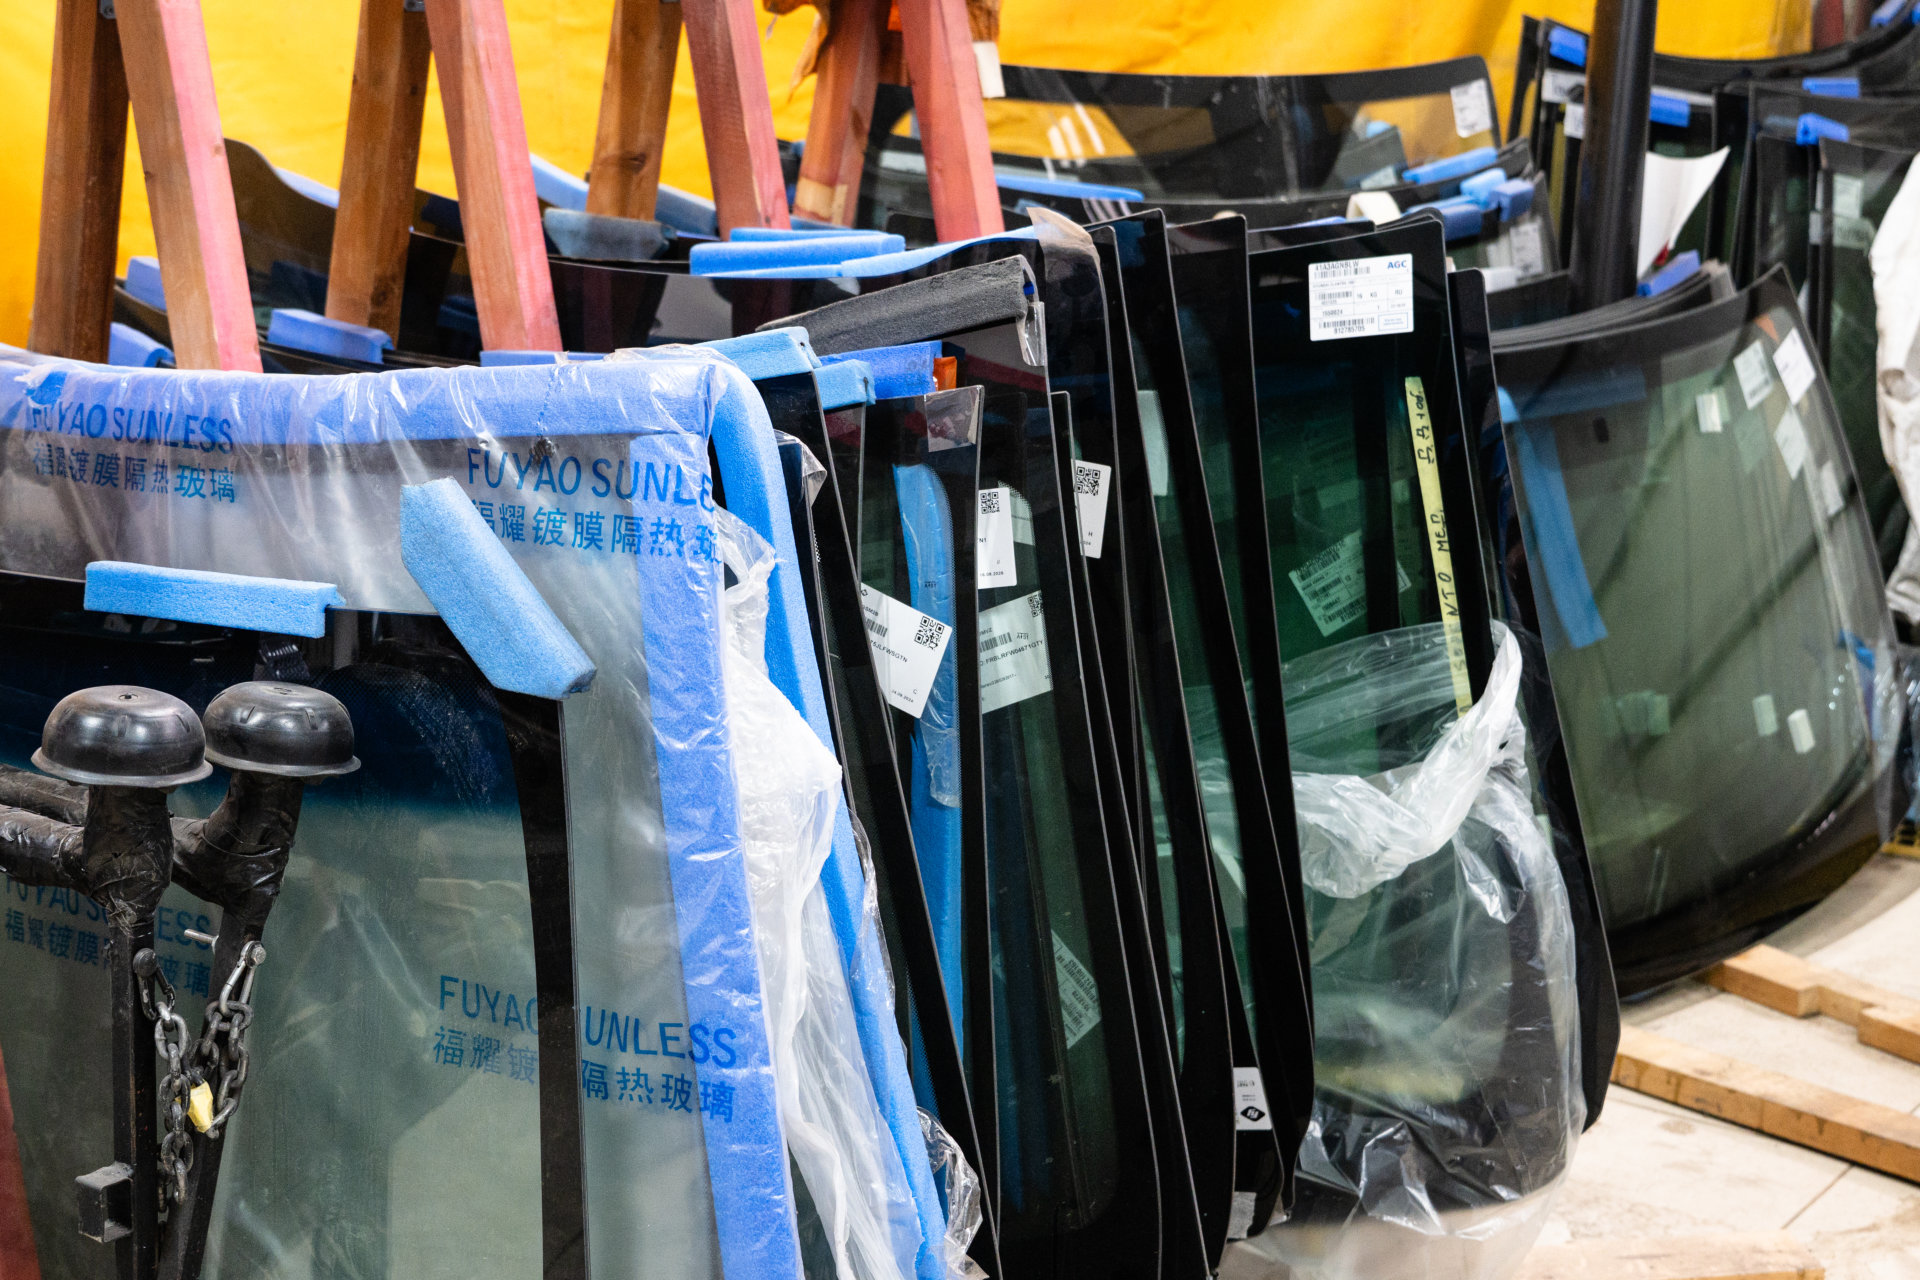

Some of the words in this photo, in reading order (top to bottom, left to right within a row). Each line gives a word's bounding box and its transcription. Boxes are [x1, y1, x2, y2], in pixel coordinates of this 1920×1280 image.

[1387, 260, 1407, 269] AGC
[32, 401, 107, 438] FUYAO
[112, 406, 233, 454] SUNLESS
[467, 447, 581, 495] FUYAO
[585, 1006, 737, 1069] UNLESS
